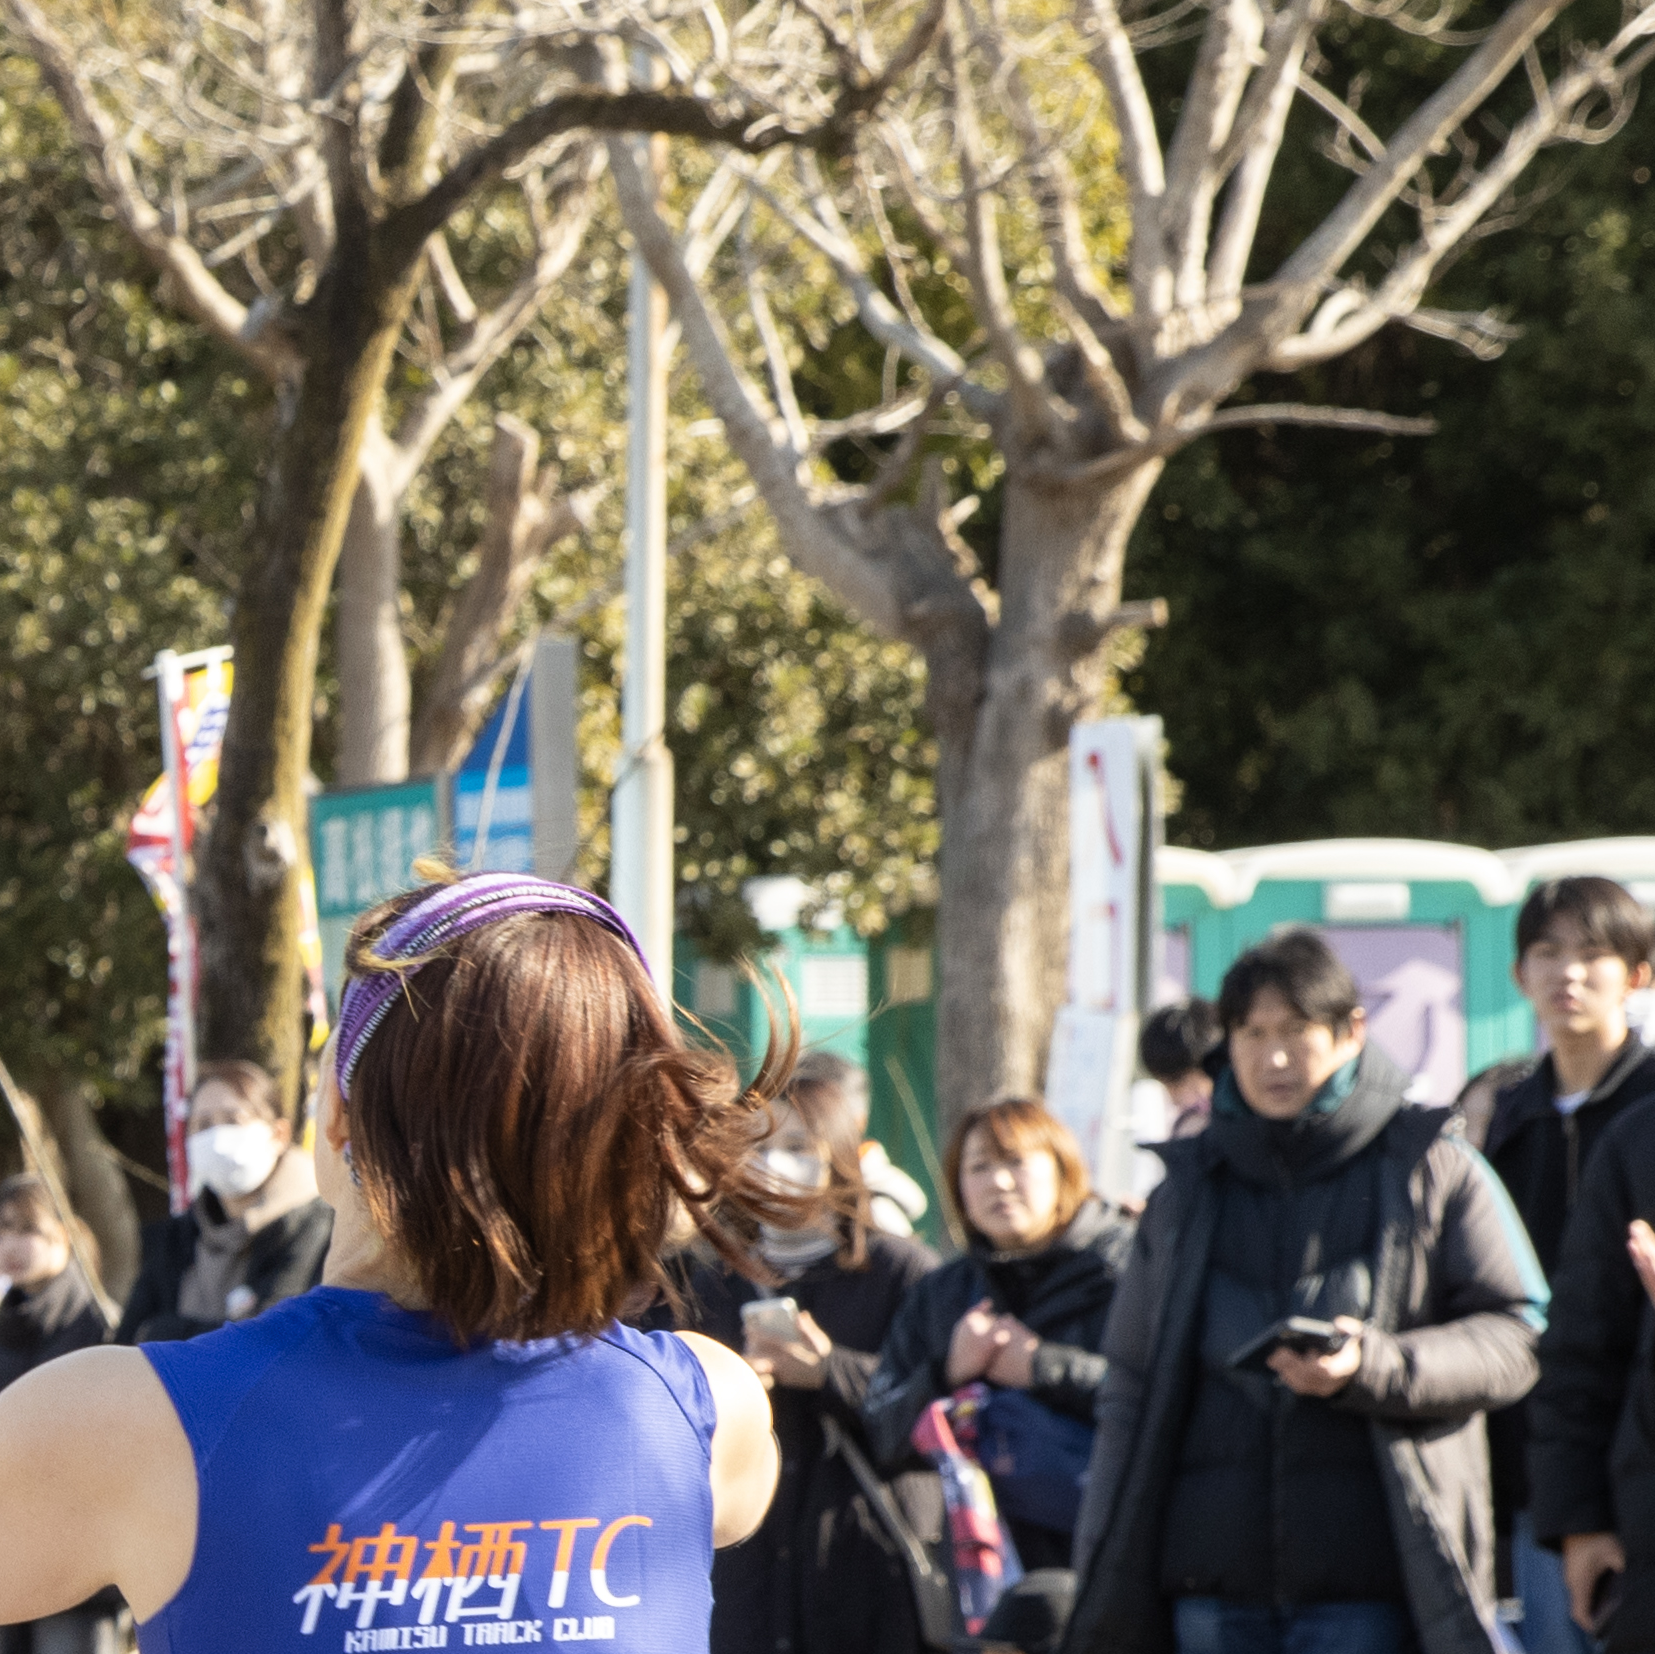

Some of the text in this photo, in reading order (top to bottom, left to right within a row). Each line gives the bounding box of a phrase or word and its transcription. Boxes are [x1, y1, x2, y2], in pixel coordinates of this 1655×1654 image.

[293, 1515, 653, 1635] 神栖TC
[344, 1616, 616, 1653] KAMISU TRACK CLUB
